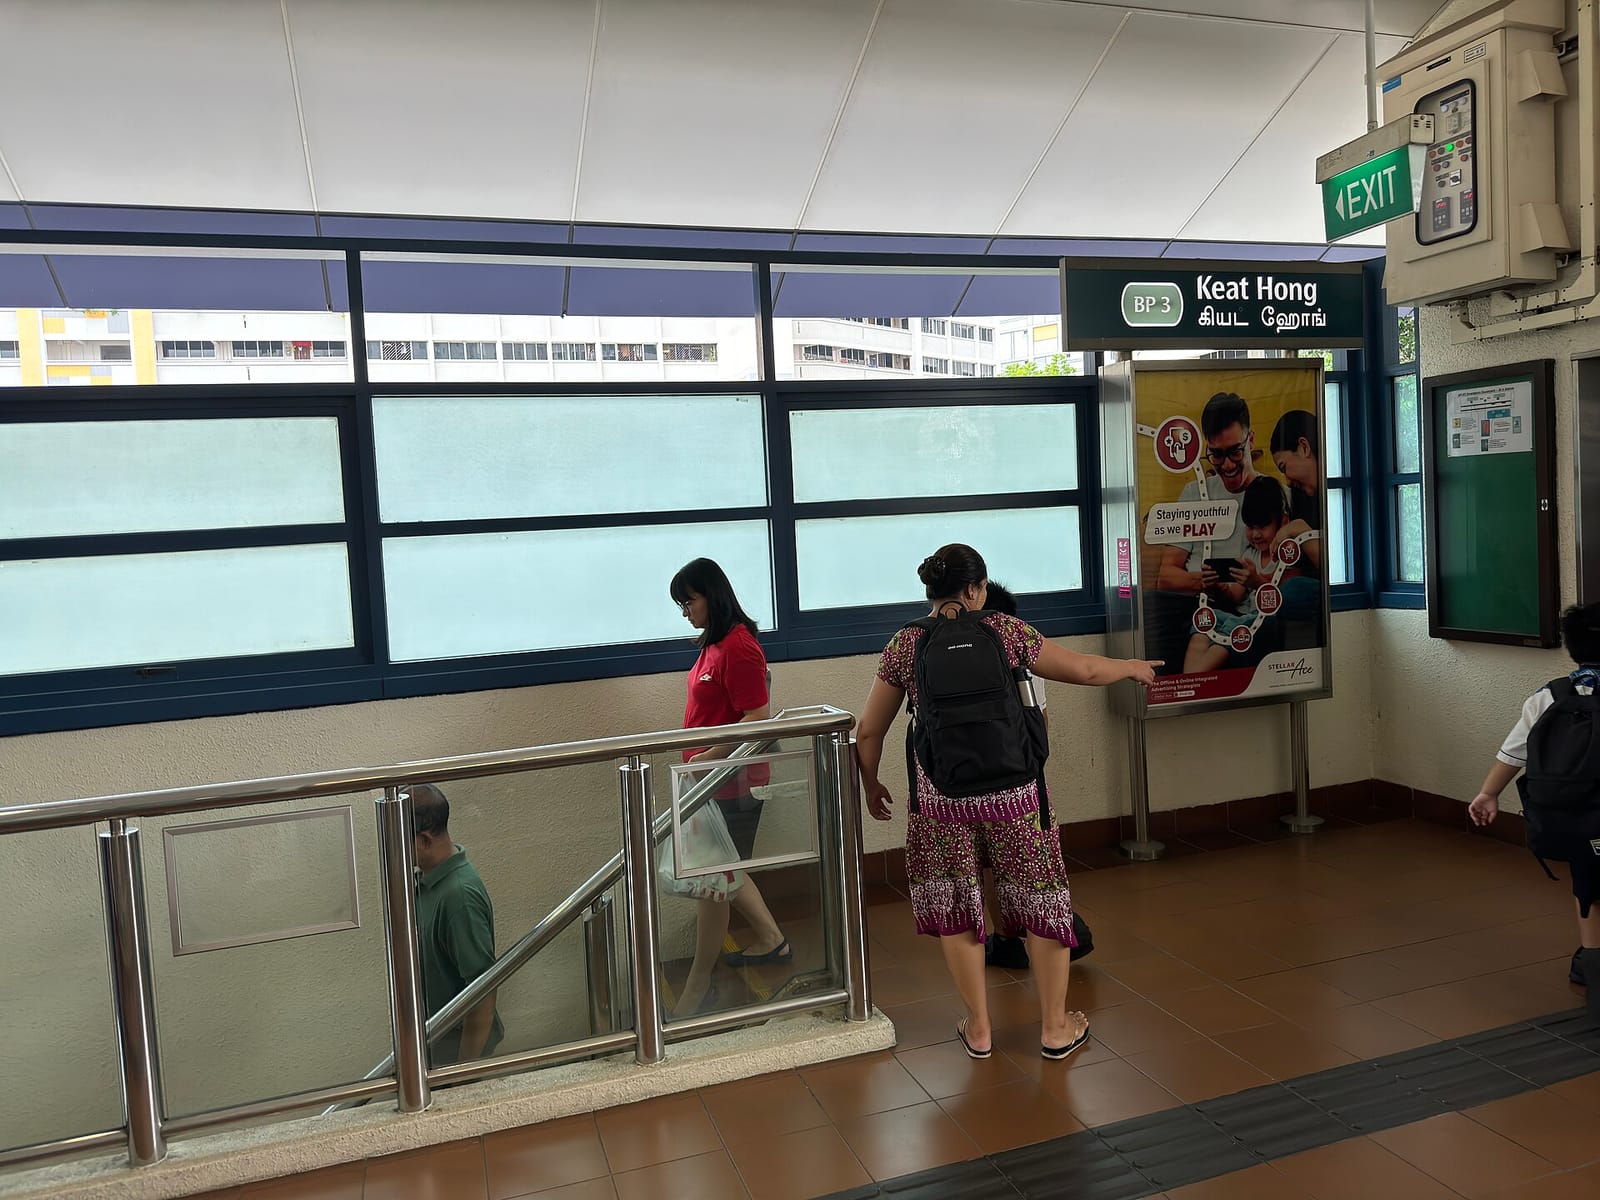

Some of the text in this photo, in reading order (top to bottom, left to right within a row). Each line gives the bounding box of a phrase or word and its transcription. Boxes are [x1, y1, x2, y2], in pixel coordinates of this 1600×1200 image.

[1347, 165, 1396, 219] EXIT
[1196, 275, 1318, 306] Keat Hong
[1133, 295, 1172, 313] BP 3
[1156, 506, 1230, 521] Staying youthful
[1154, 523, 1216, 537] as we PLAY
[1268, 658, 1313, 679] STELLAR Ace
